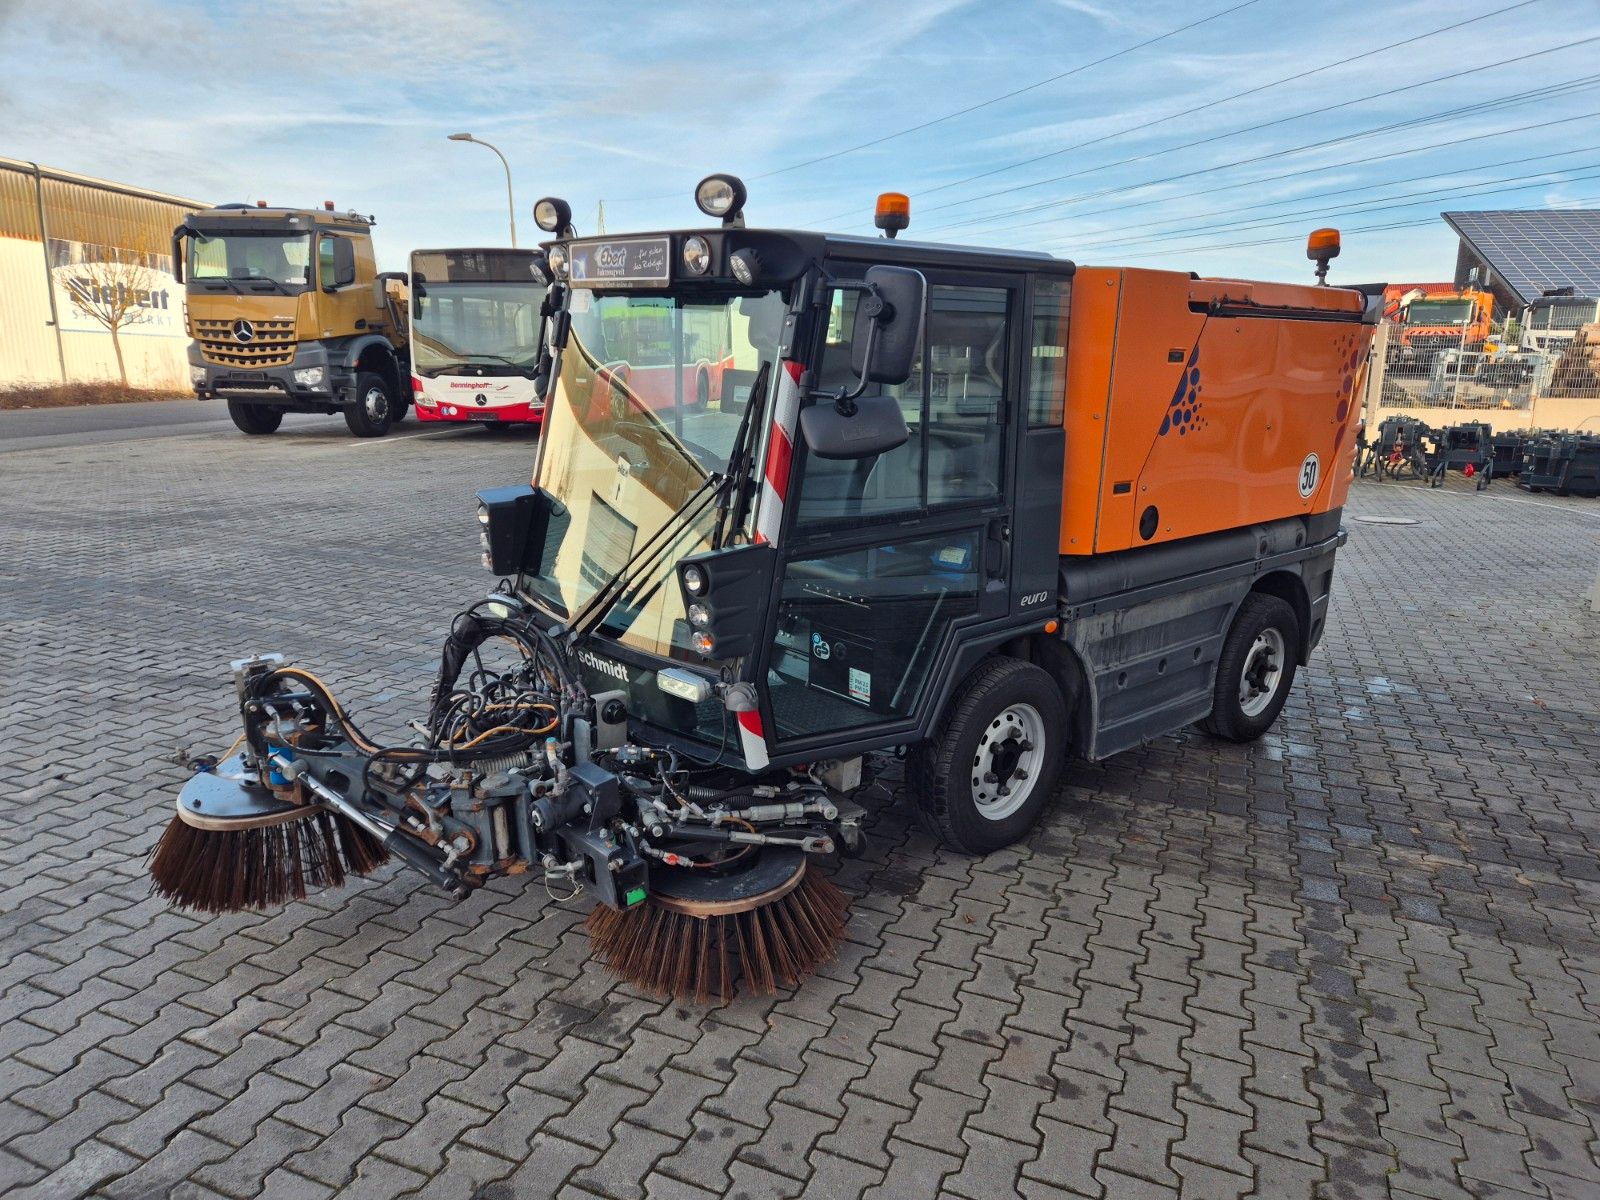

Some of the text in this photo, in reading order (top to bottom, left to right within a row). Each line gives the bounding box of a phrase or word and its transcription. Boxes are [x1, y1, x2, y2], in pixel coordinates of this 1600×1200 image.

[1302, 461, 1317, 490] 50
[1020, 591, 1048, 606] euro
[815, 643, 828, 656] GS
[578, 650, 630, 682] schmidt
